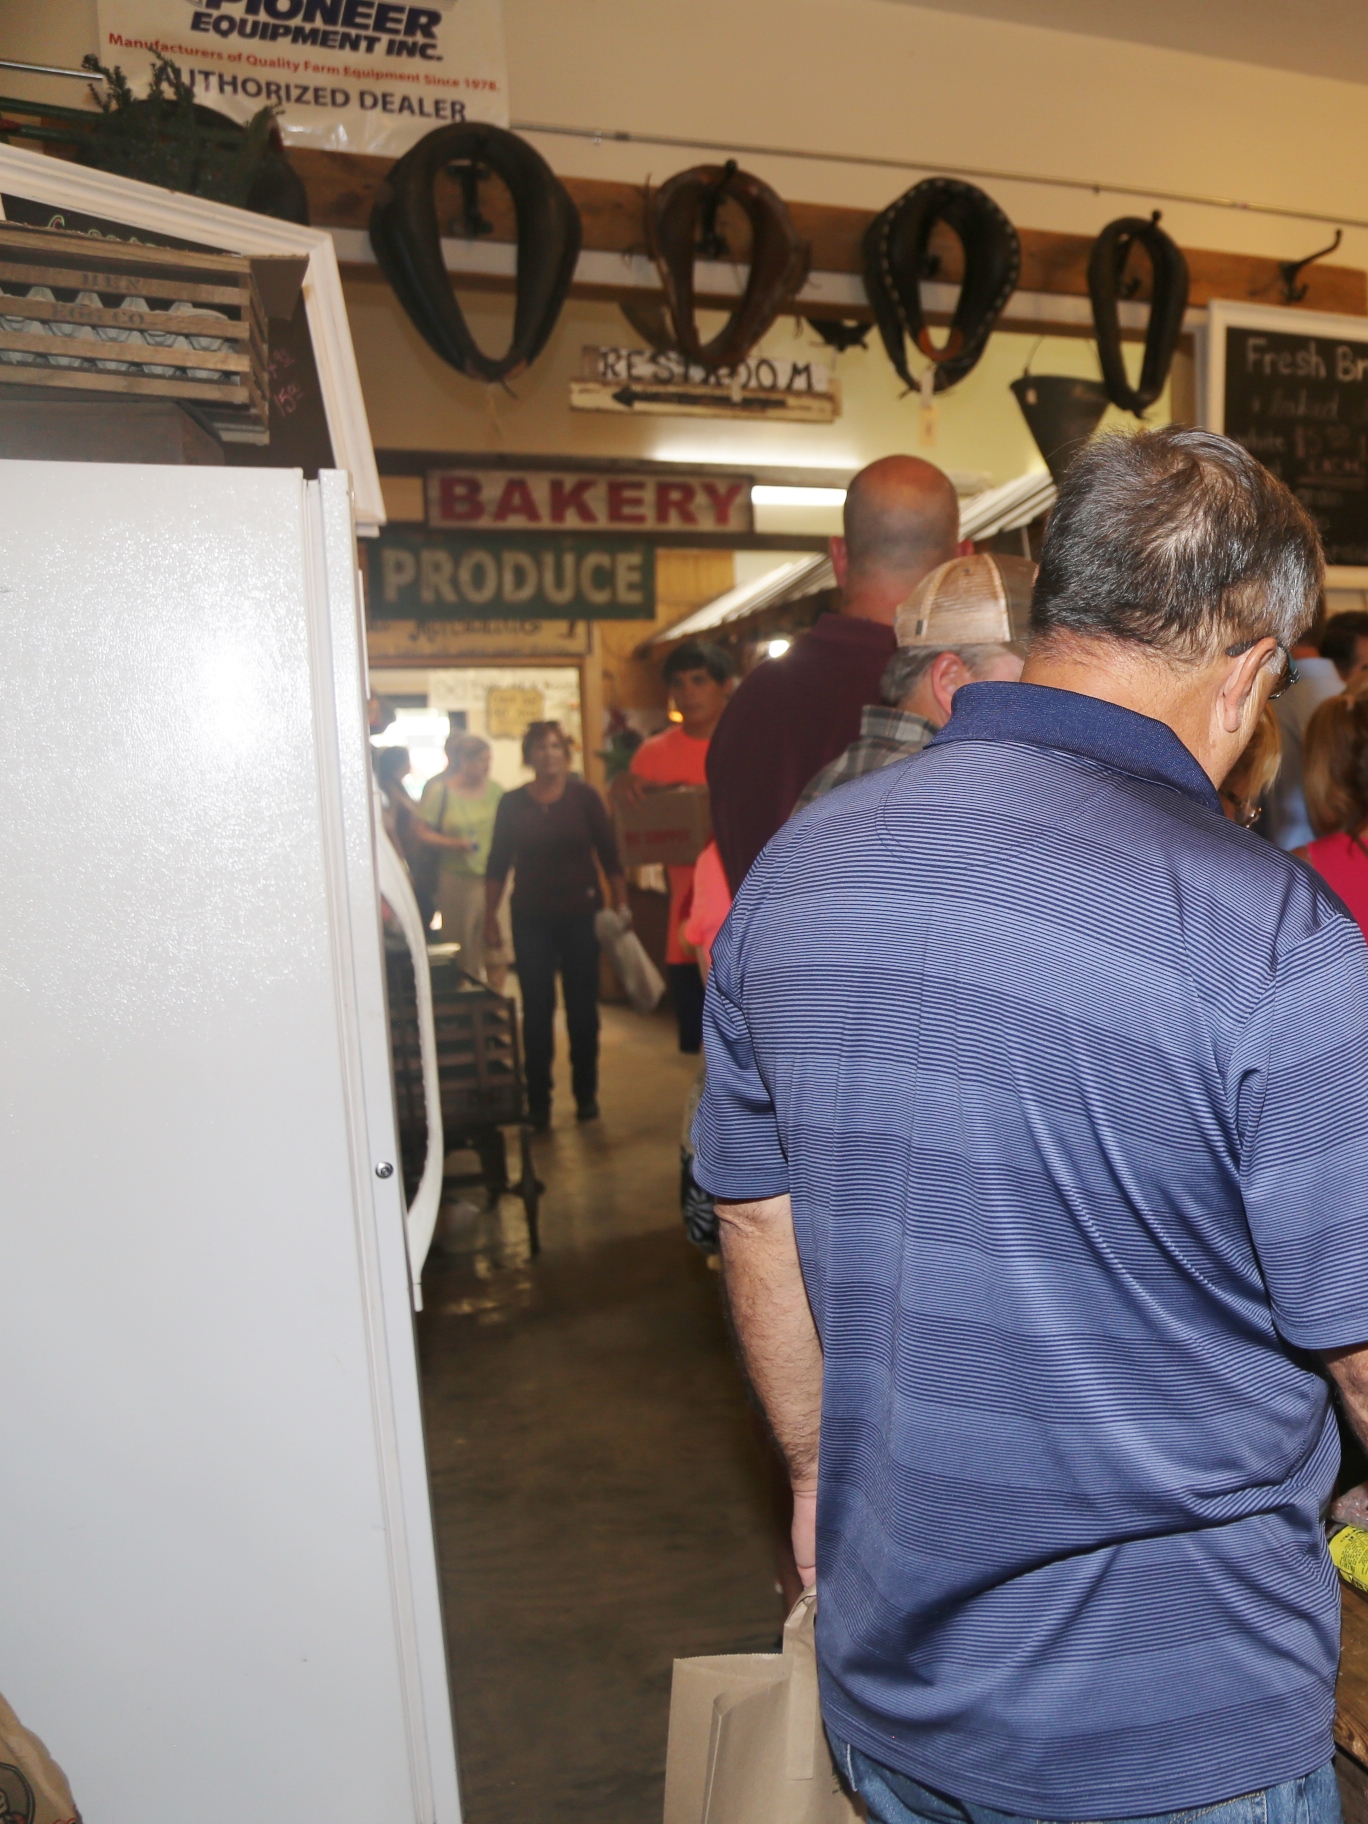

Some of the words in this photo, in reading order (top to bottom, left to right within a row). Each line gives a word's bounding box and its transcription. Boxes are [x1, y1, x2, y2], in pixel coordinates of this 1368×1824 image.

[109, 32, 224, 61] Manufacturers
[227, 50, 243, 63] of
[246, 54, 300, 74] Quality
[303, 61, 340, 76] Farm
[343, 66, 420, 82] Equipment
[424, 74, 460, 88] Since
[190, 11, 381, 54] EQUIPMENT
[385, 38, 443, 61] INC.
[157, 63, 351, 108] AUTHORIZED
[359, 90, 466, 122] DEALER
[1247, 337, 1327, 379] Fresh
[438, 475, 744, 527] BAKERY
[382, 548, 645, 604] PRODUCE
